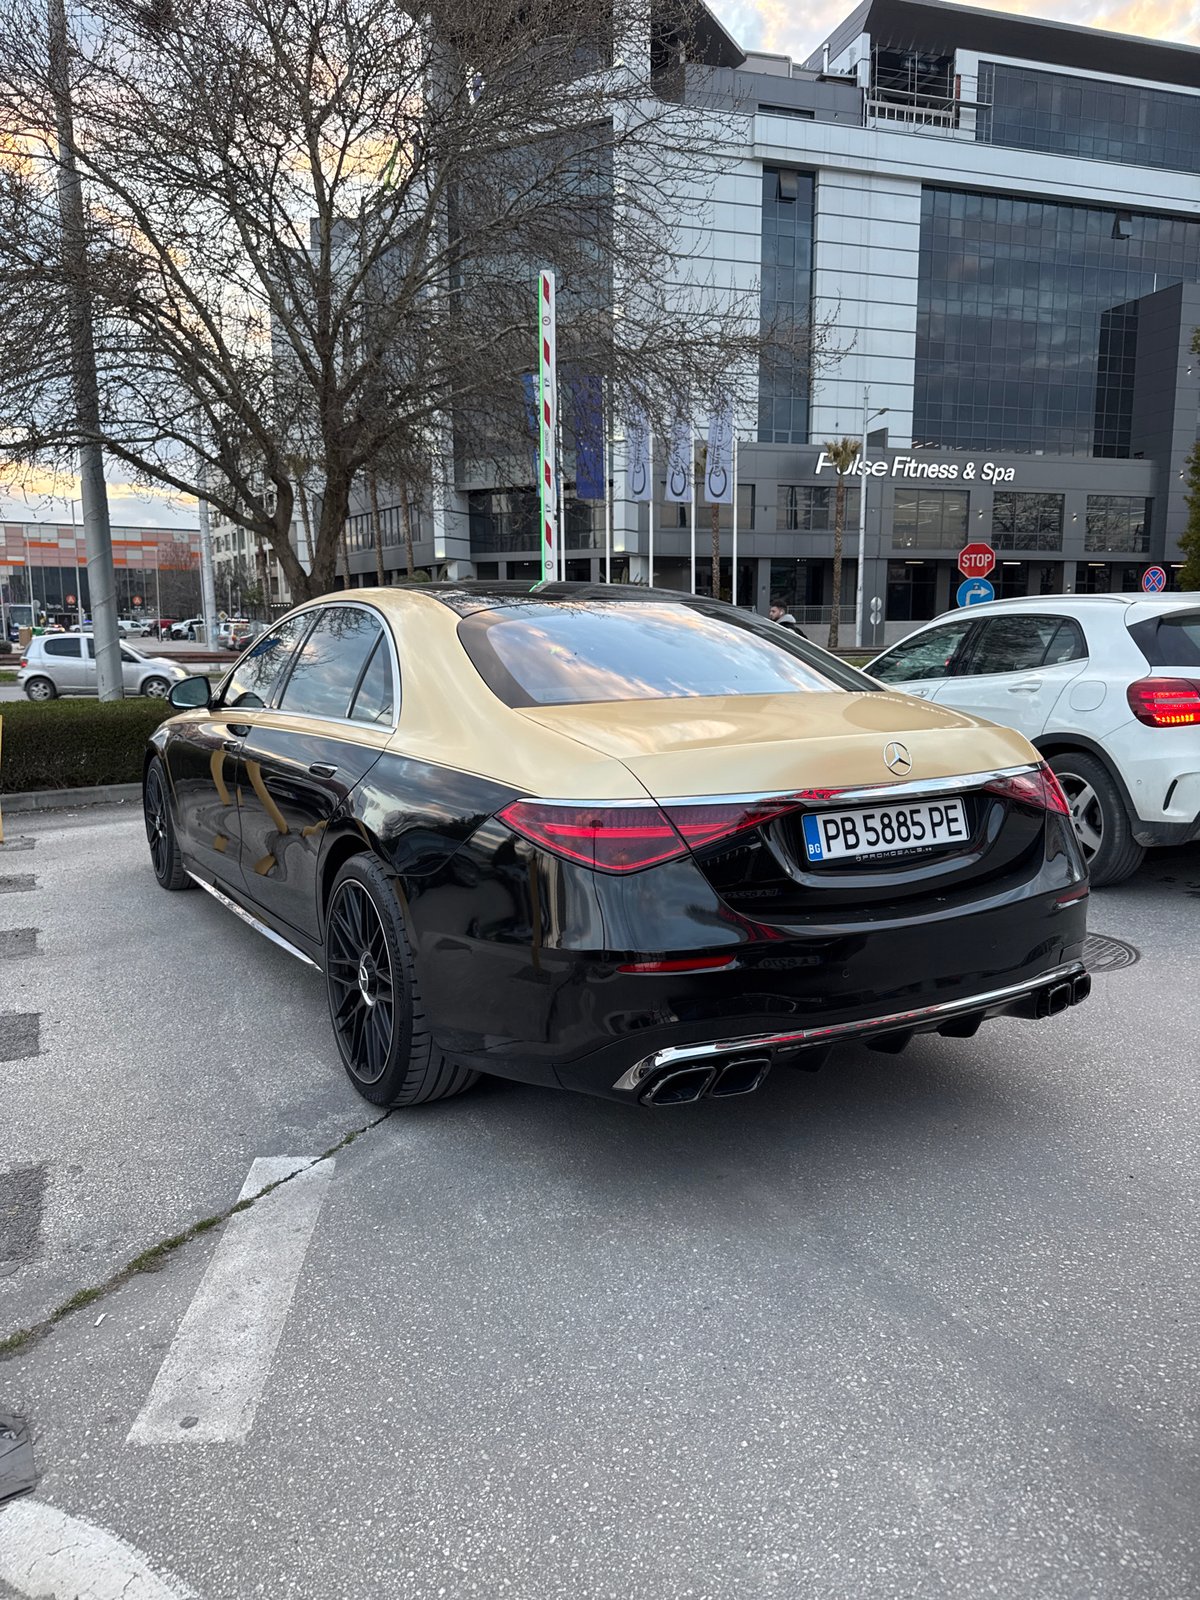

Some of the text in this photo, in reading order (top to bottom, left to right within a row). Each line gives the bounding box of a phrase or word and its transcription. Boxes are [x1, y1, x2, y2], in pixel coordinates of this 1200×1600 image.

[891, 455, 958, 479] Fitness
[962, 461, 976, 480] &
[981, 462, 1015, 485] Spa
[961, 553, 992, 567] STOP
[822, 804, 962, 852] PB 5885 PE
[808, 843, 820, 854] BG
